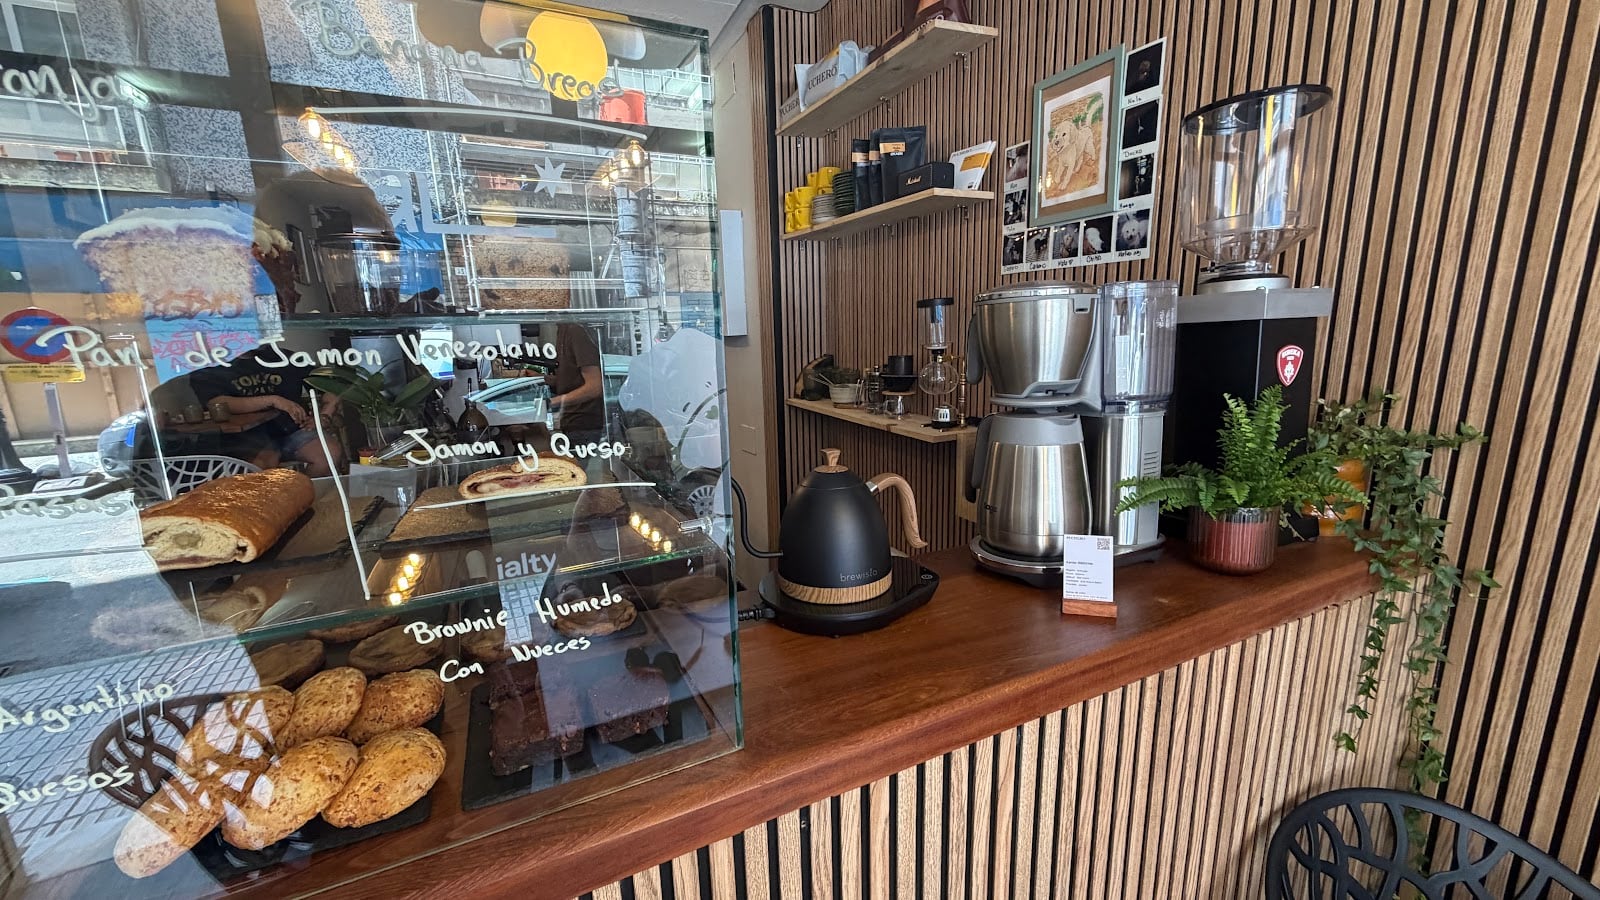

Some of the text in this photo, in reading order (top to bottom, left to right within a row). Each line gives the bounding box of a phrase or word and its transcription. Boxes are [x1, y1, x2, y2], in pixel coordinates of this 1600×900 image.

[298, 0, 623, 101] Banana Bread
[0, 64, 130, 123] anja
[36, 325, 148, 370] Pan
[185, 331, 232, 368] de
[254, 335, 382, 368] Jamon
[396, 329, 557, 366] Venezolano
[231, 374, 283, 390] TOKYO
[402, 428, 626, 471] Jamon y Queso
[403, 582, 623, 645] Brownie Humedo
[439, 635, 591, 683] Con Nueces
[0, 683, 174, 733] Argentino
